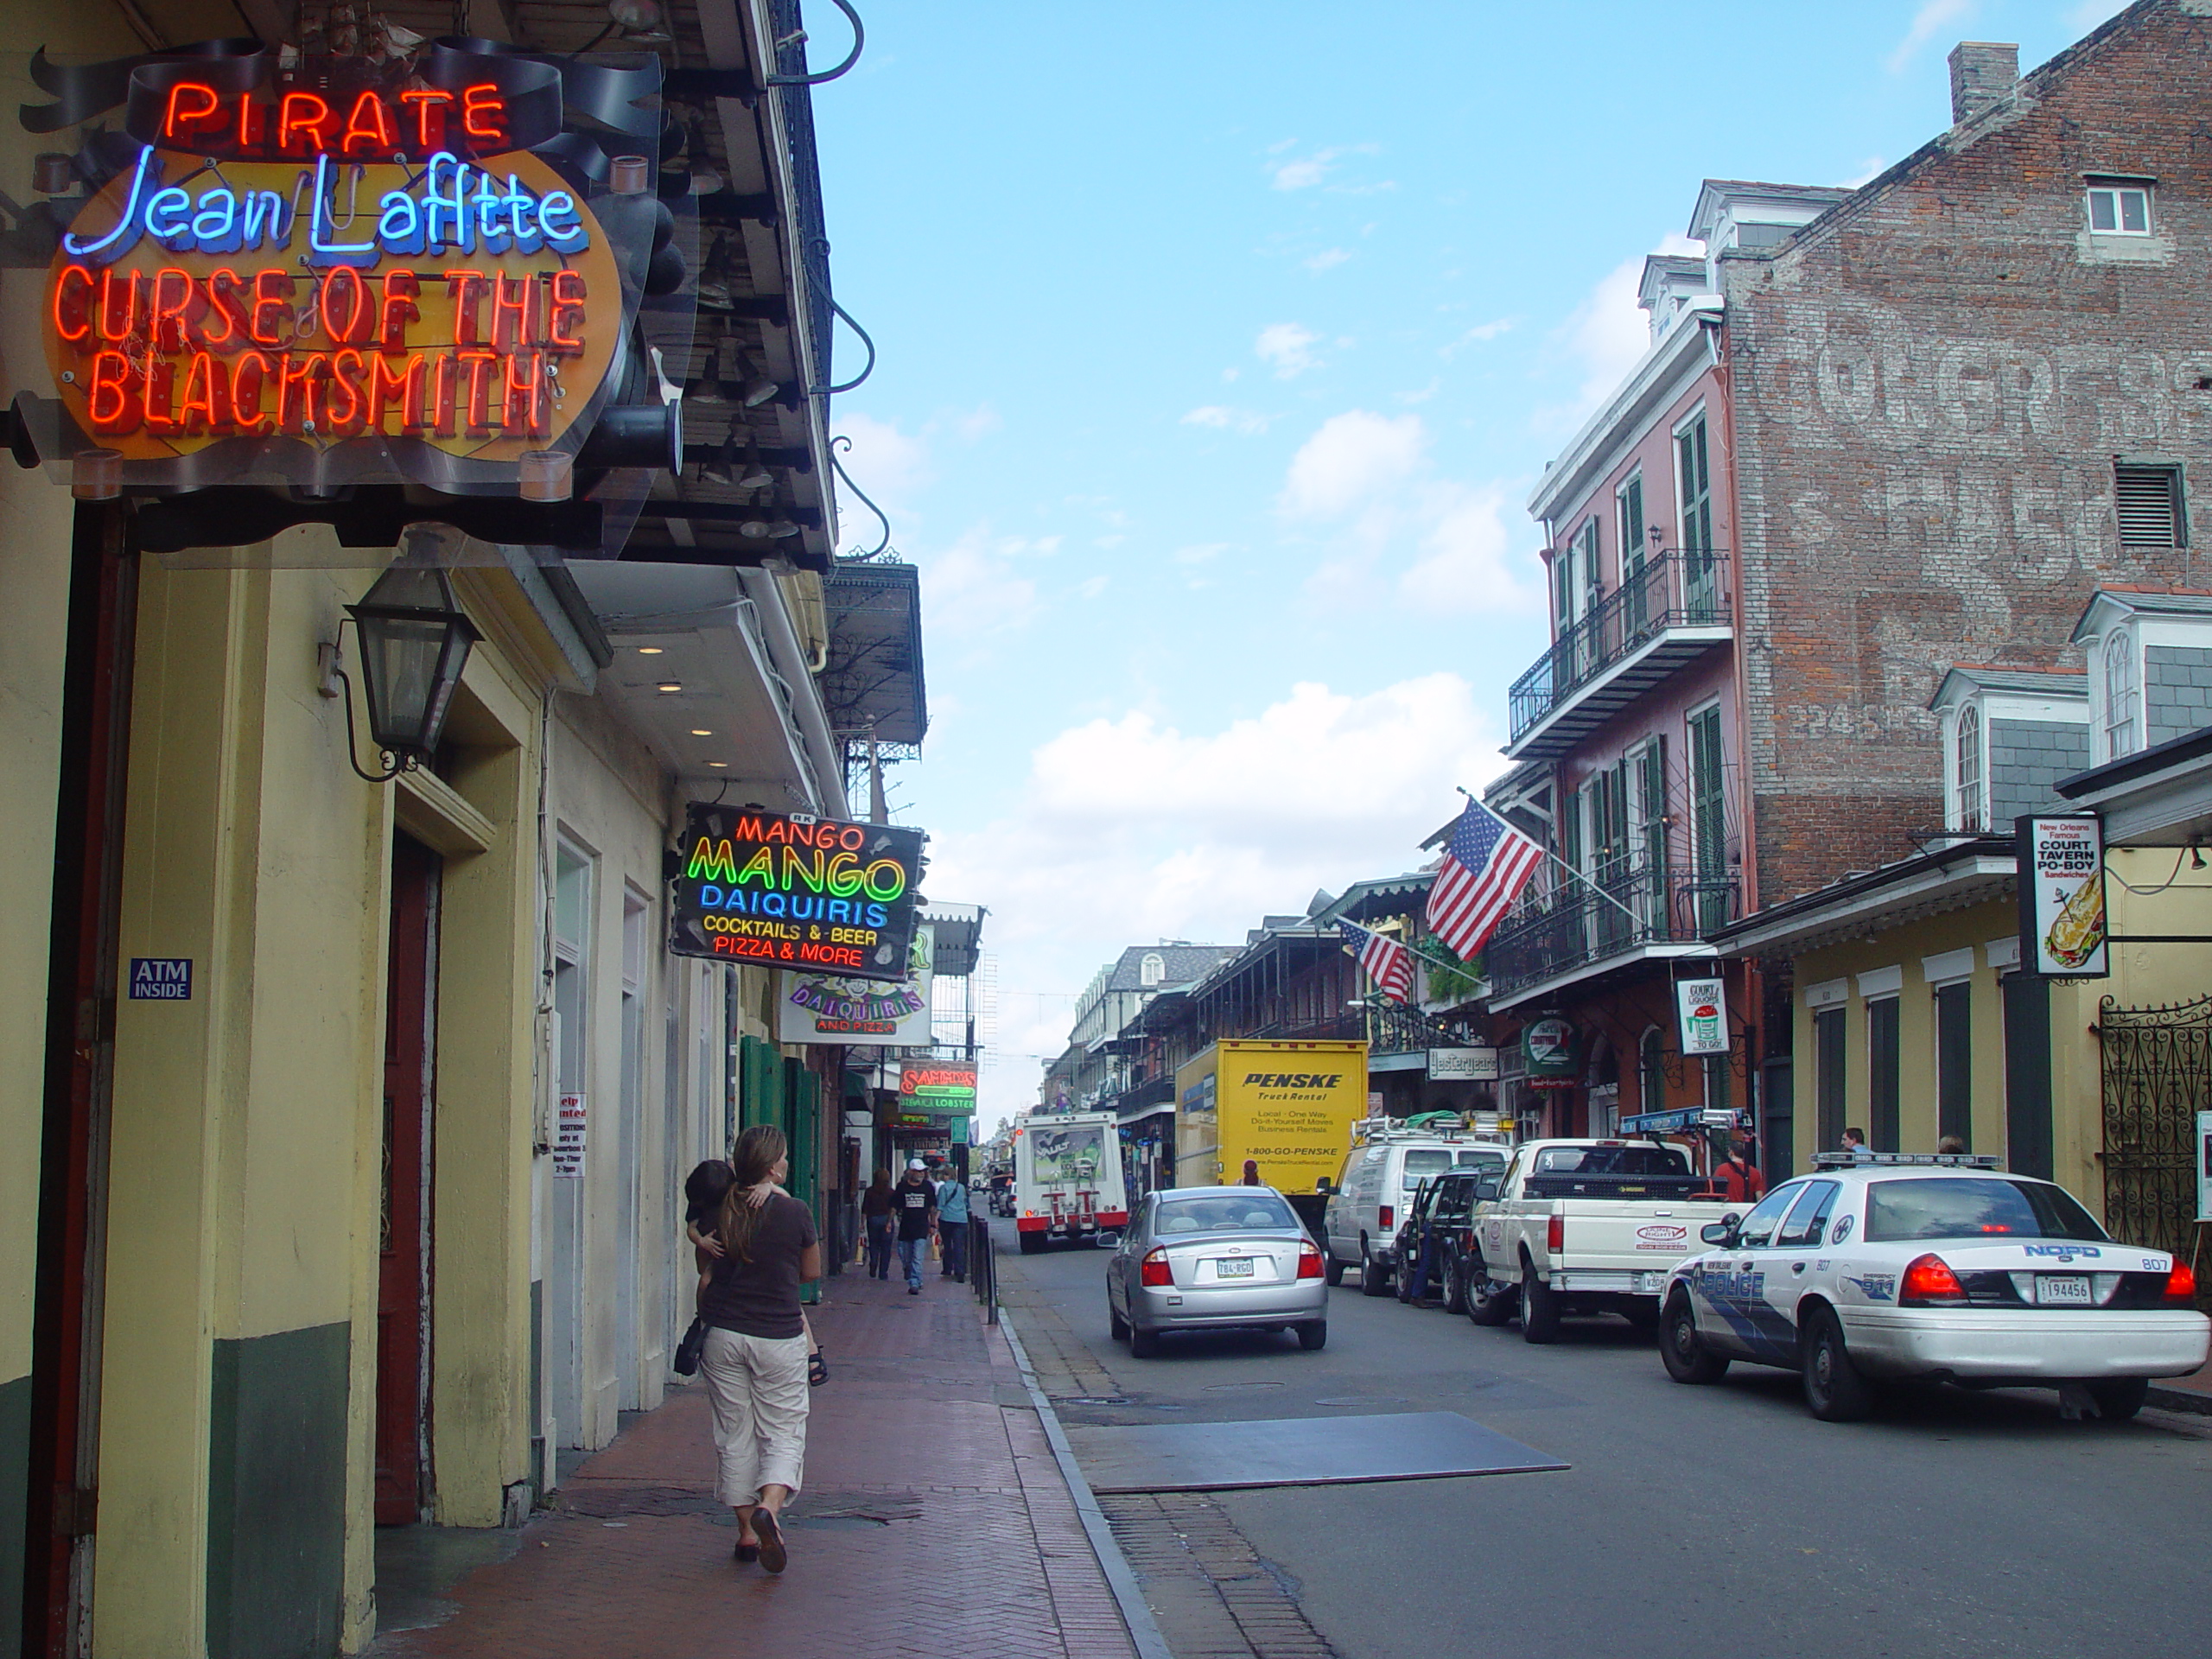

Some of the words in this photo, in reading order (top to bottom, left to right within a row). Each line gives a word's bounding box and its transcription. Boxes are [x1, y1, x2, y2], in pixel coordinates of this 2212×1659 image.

[164, 83, 508, 154] PIRATE
[64, 145, 287, 256] Jean
[54, 265, 292, 346] CURSE
[321, 265, 419, 347] OF
[446, 269, 588, 347] THE
[90, 348, 544, 429] BLACKSMITH
[736, 817, 863, 850] MANGO
[2040, 841, 2091, 850] COURT
[2037, 851, 2094, 860] TAVERN
[688, 836, 906, 901] MANGO
[2037, 861, 2094, 870] PO-BOY
[700, 885, 888, 928] DAIQUIRIS
[703, 915, 800, 940] COCKTAILS
[809, 925, 821, 940] &
[830, 927, 877, 946] BEER
[715, 936, 775, 959] PIZZA
[780, 944, 794, 960] &
[801, 945, 863, 967] MORE
[136, 961, 188, 982] ATM
[135, 983, 187, 998] INSIDE
[1689, 984, 1714, 996] COURT
[791, 988, 925, 1020] DAIQUIRIS
[817, 1020, 850, 1033] AND
[853, 1021, 894, 1033] PIZZA
[1431, 1052, 1497, 1077] Yesteryears
[1242, 1073, 1343, 1088] PENSKE
[935, 1098, 974, 1109] LOBSTER
[1036, 1140, 1071, 1157] VAULT
[2024, 1246, 2101, 1258] NOPD
[1816, 1260, 1831, 1271] 807
[2142, 1258, 2168, 1271] 807
[1702, 1272, 1765, 1300] POLICE
[1861, 1279, 1895, 1294] 911
[2048, 1283, 2088, 1297] 194456
